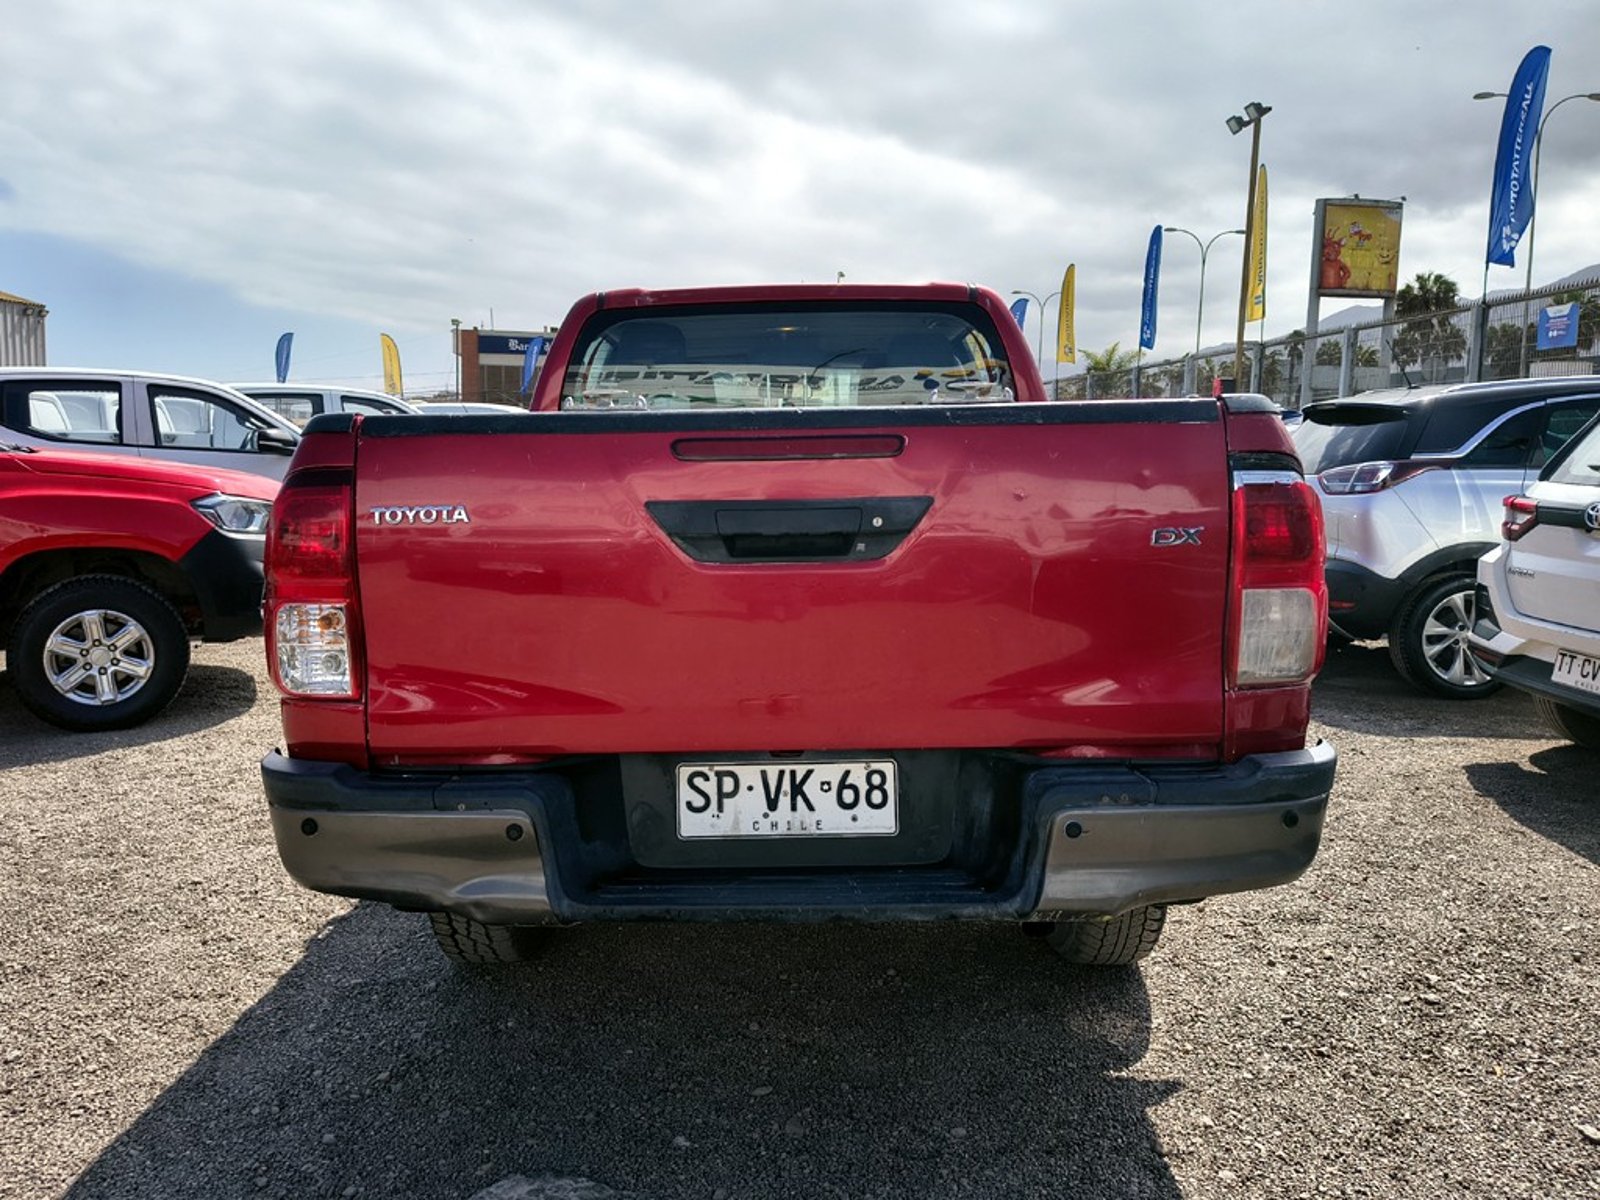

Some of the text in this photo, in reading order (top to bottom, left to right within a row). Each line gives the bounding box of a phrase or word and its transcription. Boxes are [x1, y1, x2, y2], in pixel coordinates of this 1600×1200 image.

[370, 505, 470, 525] TOYOTA
[1150, 526, 1205, 547] DX
[752, 819, 824, 833] CHILE
